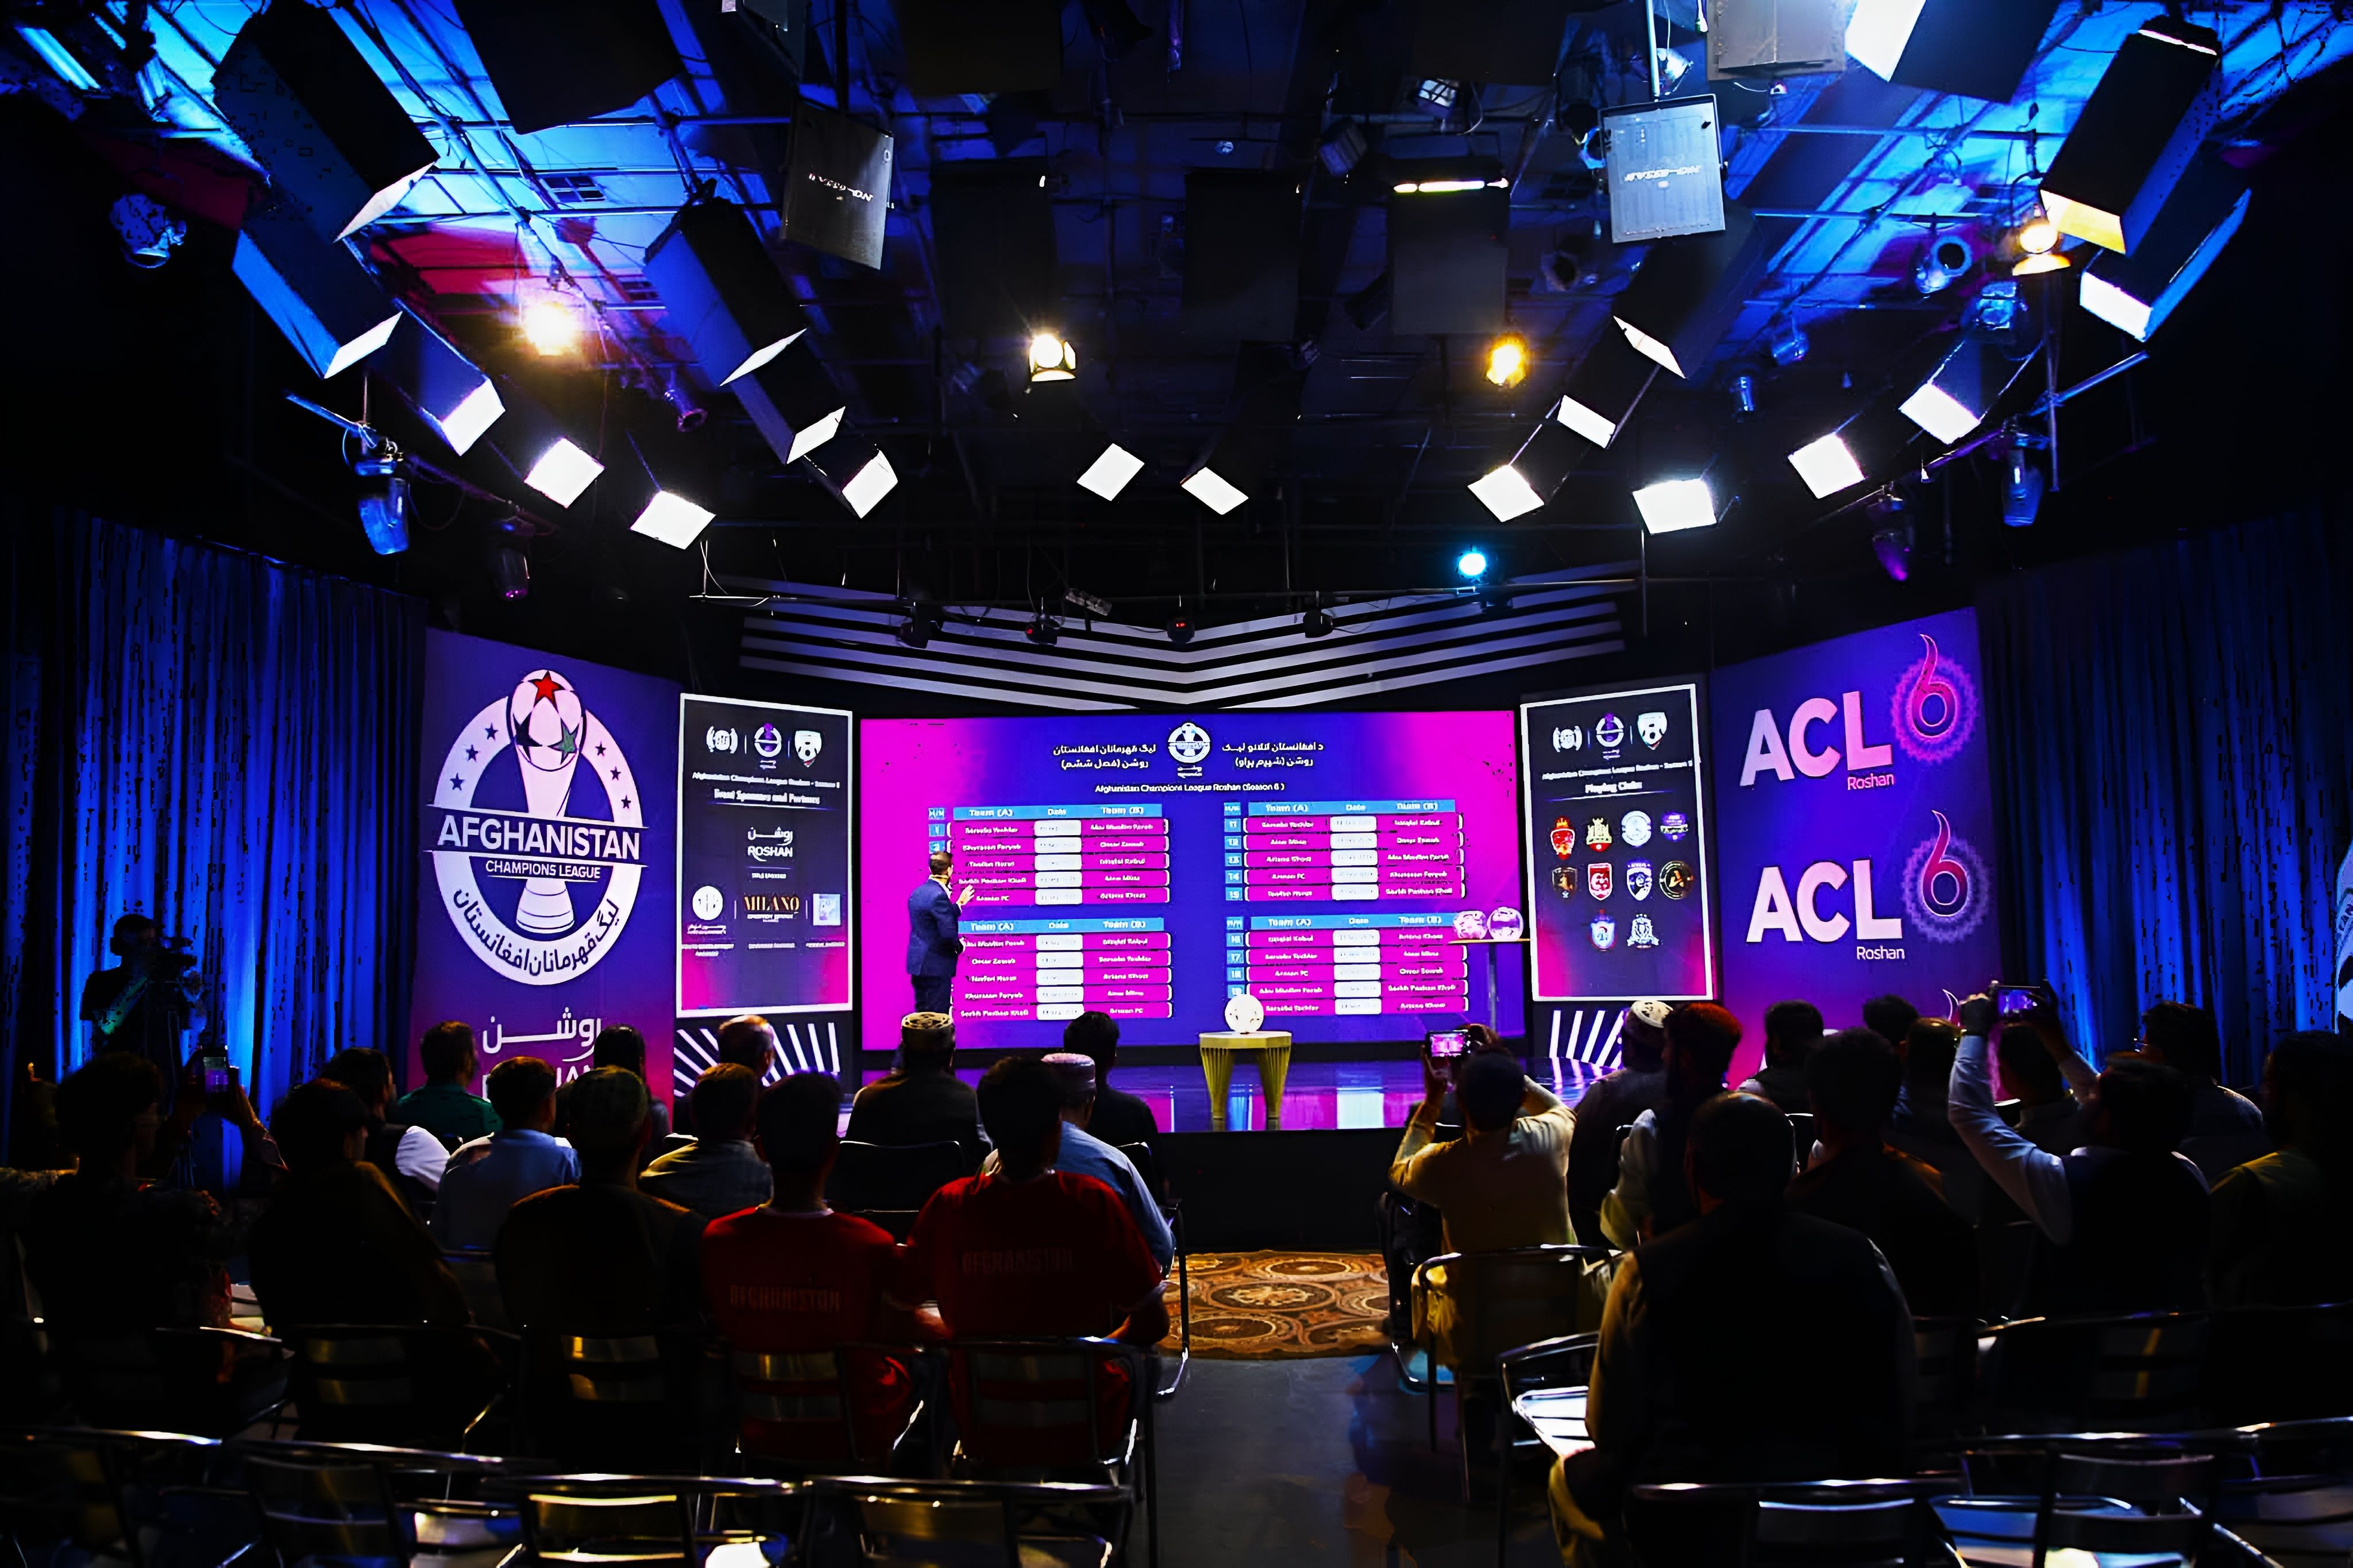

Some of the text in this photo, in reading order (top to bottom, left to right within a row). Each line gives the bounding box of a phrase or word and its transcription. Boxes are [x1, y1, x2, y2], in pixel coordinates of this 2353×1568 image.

[1739, 690, 1892, 789] ACL
[1847, 772, 1895, 791] Roshan
[437, 814, 640, 860] AFGHANISTAN
[747, 827, 793, 846] روشن
[747, 845, 793, 862] ROSHAN
[485, 860, 600, 879] CHAMPIONS LEAGUE
[745, 895, 800, 912] MILANO
[1746, 859, 1903, 943] ACL
[453, 888, 530, 971] افغانستان
[529, 932, 597, 976] قهرمانان
[1856, 945, 1905, 961] Roshan
[483, 1006, 602, 1063] روشن
